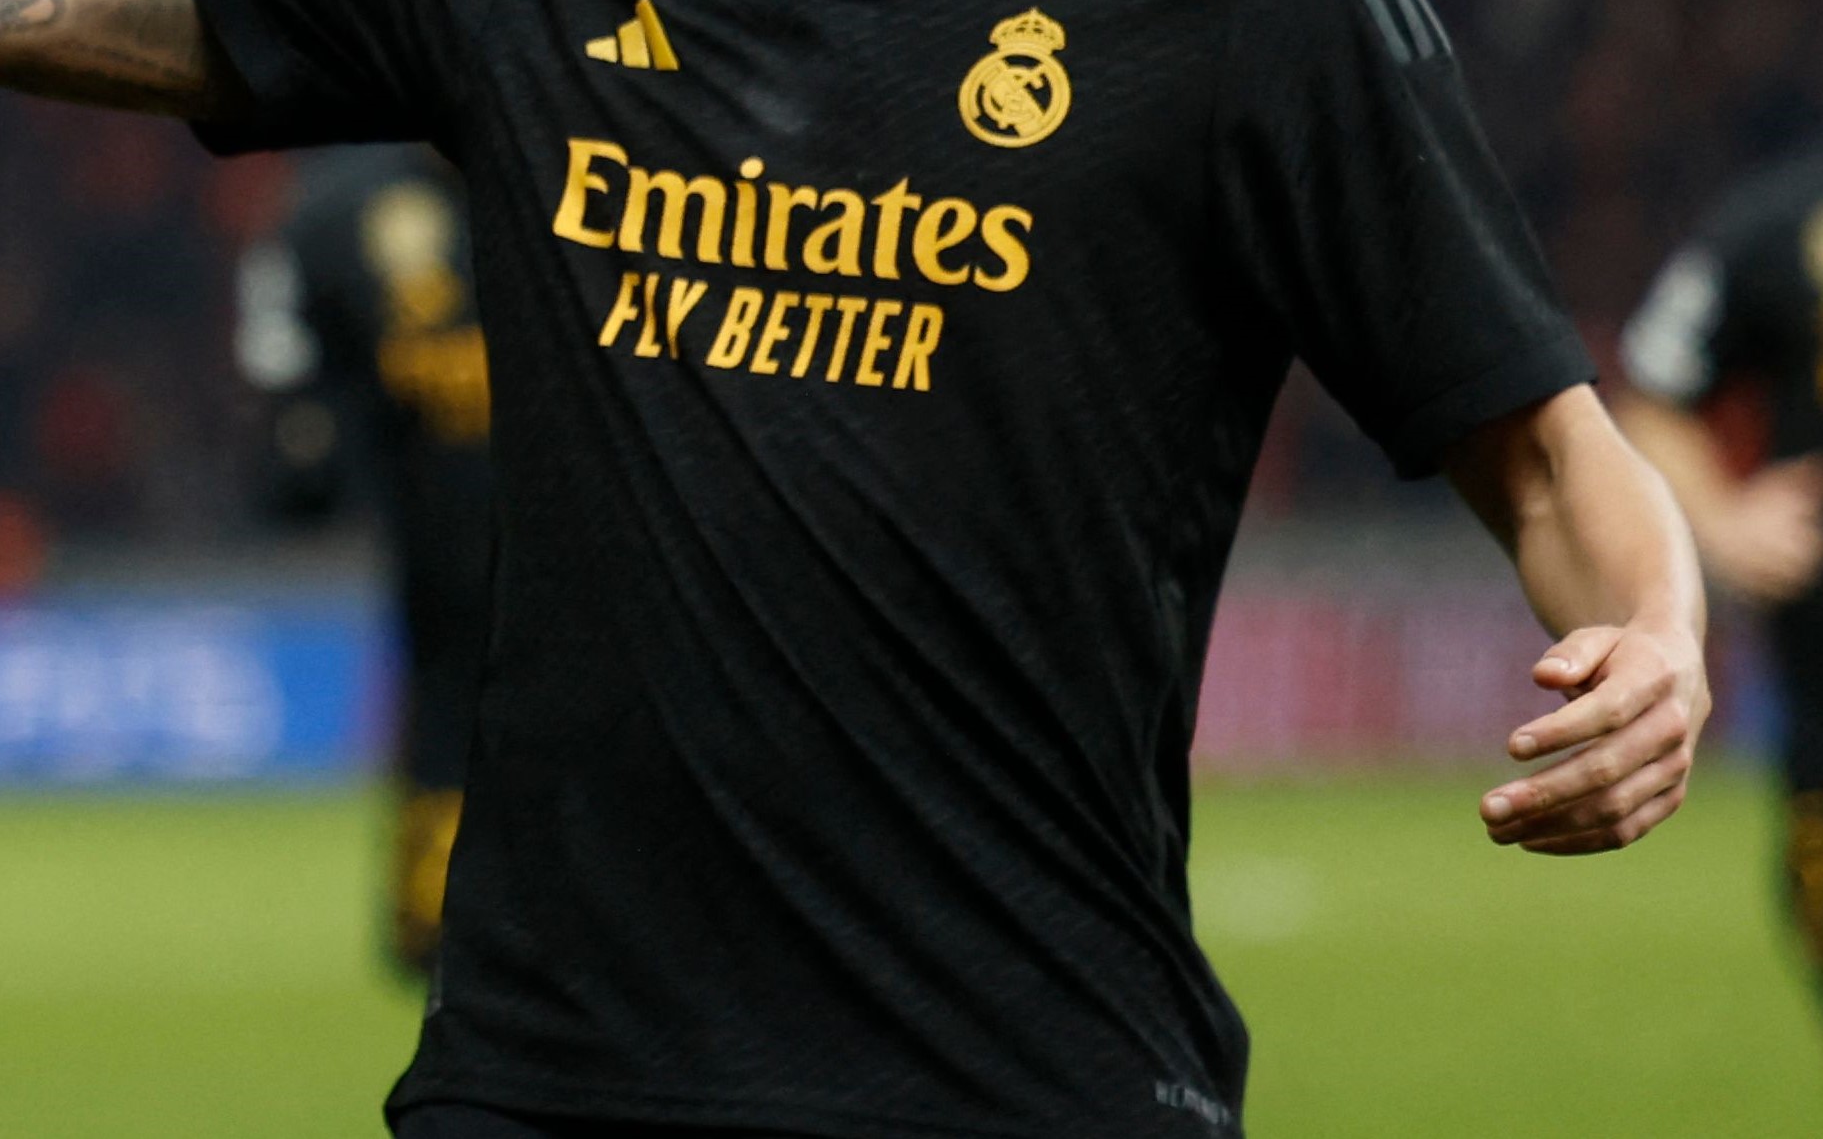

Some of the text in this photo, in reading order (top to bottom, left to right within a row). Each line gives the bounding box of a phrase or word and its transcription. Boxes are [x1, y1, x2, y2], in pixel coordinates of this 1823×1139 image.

[553, 138, 1035, 293] Emirates
[597, 272, 945, 393] FLY BETTER
